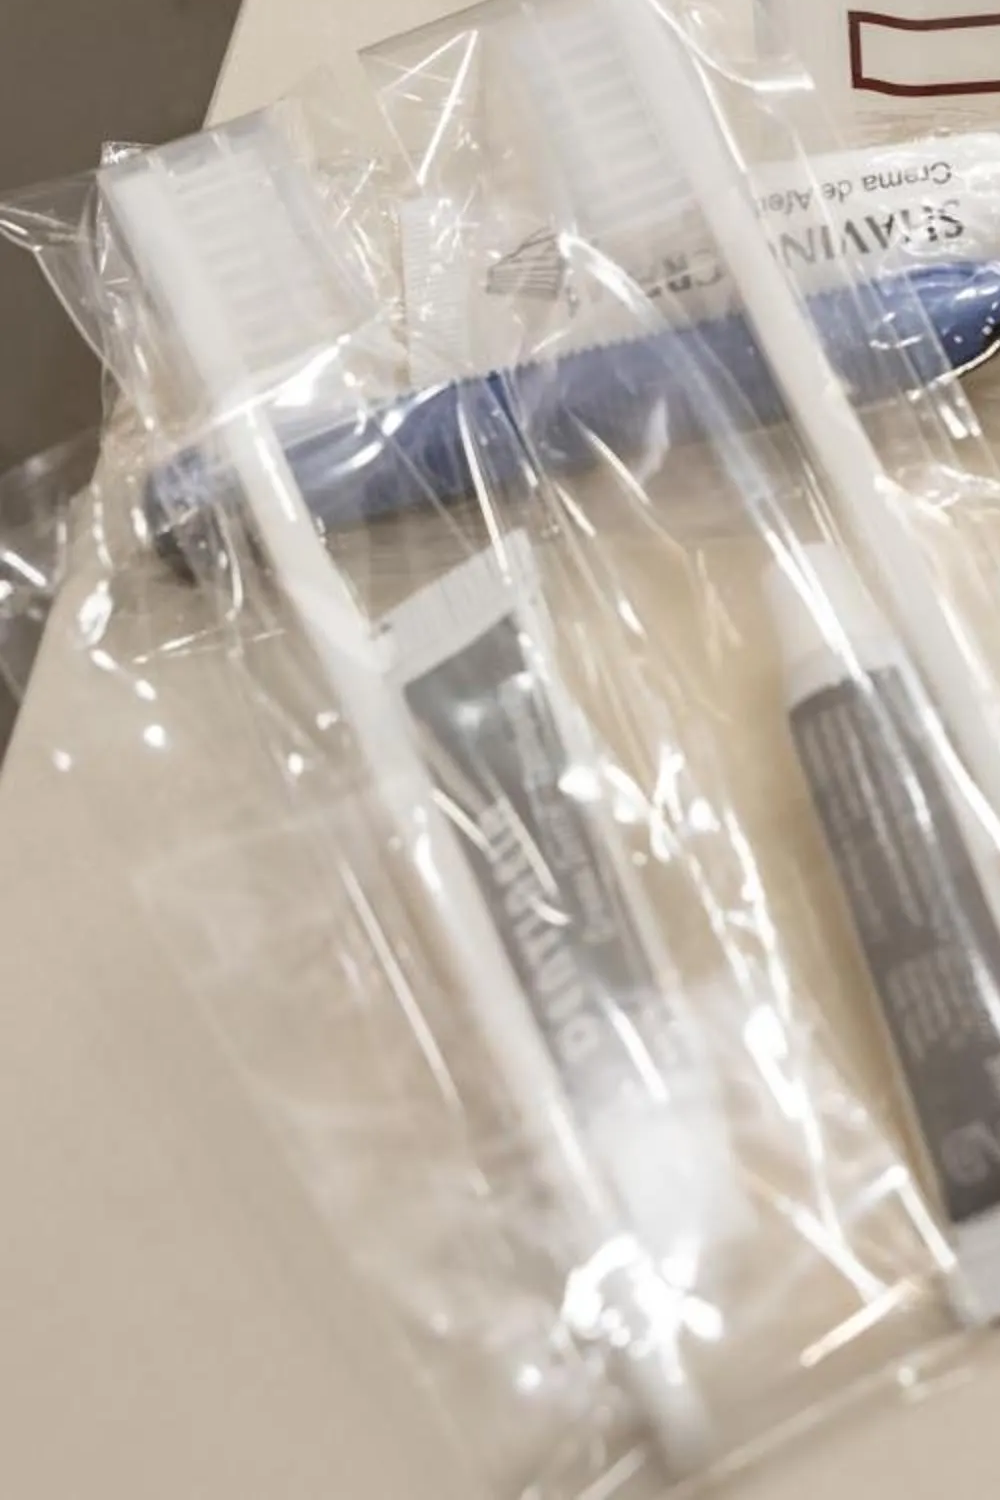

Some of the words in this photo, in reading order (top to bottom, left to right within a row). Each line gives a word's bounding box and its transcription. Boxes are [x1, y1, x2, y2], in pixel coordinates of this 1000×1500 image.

[821, 180, 853, 205] de
[861, 160, 952, 194] Crema
[767, 198, 965, 269] SHAVIN
